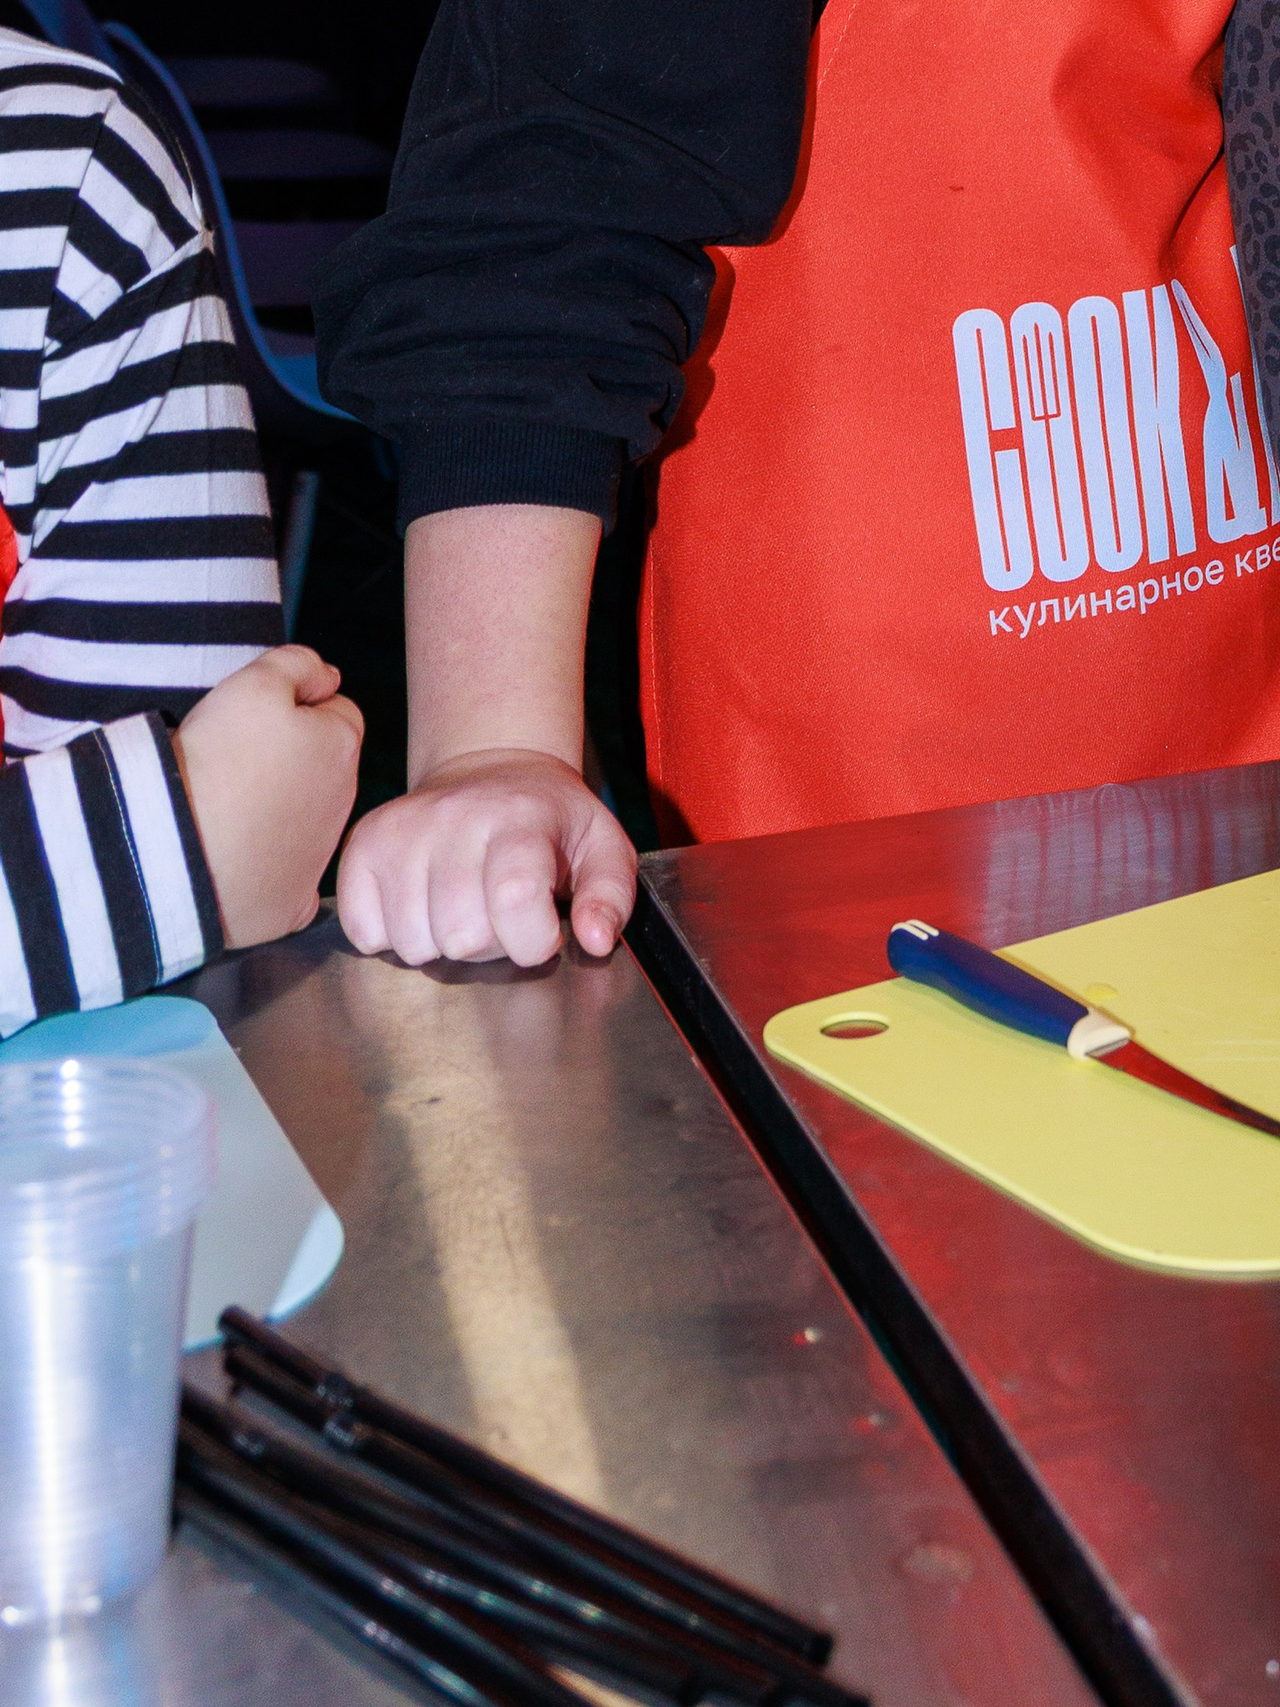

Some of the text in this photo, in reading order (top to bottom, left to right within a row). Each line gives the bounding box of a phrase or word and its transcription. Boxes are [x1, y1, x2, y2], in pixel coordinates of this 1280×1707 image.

[952, 284, 1196, 592] COOK
[1171, 279, 1267, 544] &
[988, 559, 1225, 639] кулинарное
